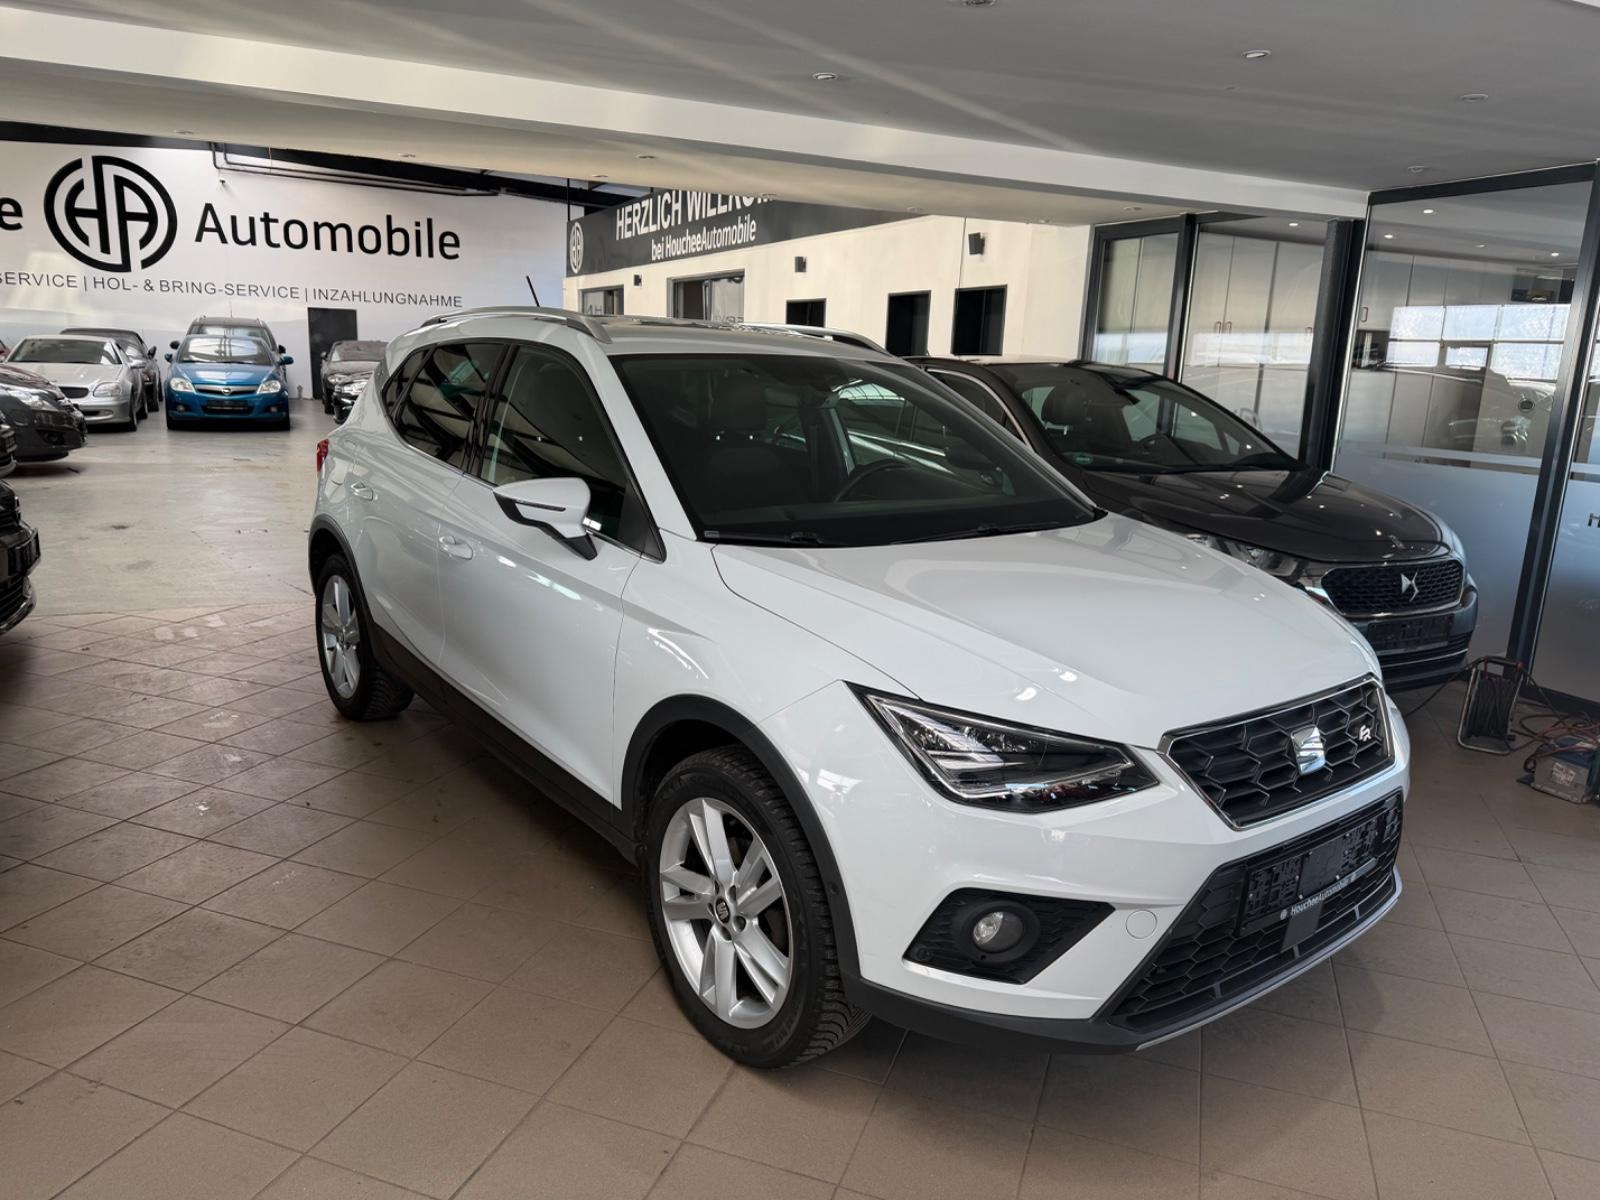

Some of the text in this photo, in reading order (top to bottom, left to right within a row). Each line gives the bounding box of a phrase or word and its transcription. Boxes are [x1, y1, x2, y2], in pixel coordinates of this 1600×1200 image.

[194, 202, 461, 260] Automobile
[616, 189, 773, 241] HERZLICH WILL
[651, 213, 757, 261] bei HoucheeAutomobile
[93, 276, 138, 290] HOL-
[144, 280, 154, 292] &
[160, 280, 300, 299] BRING-SERVICE
[313, 288, 463, 308] INZAHLUNGNAHME
